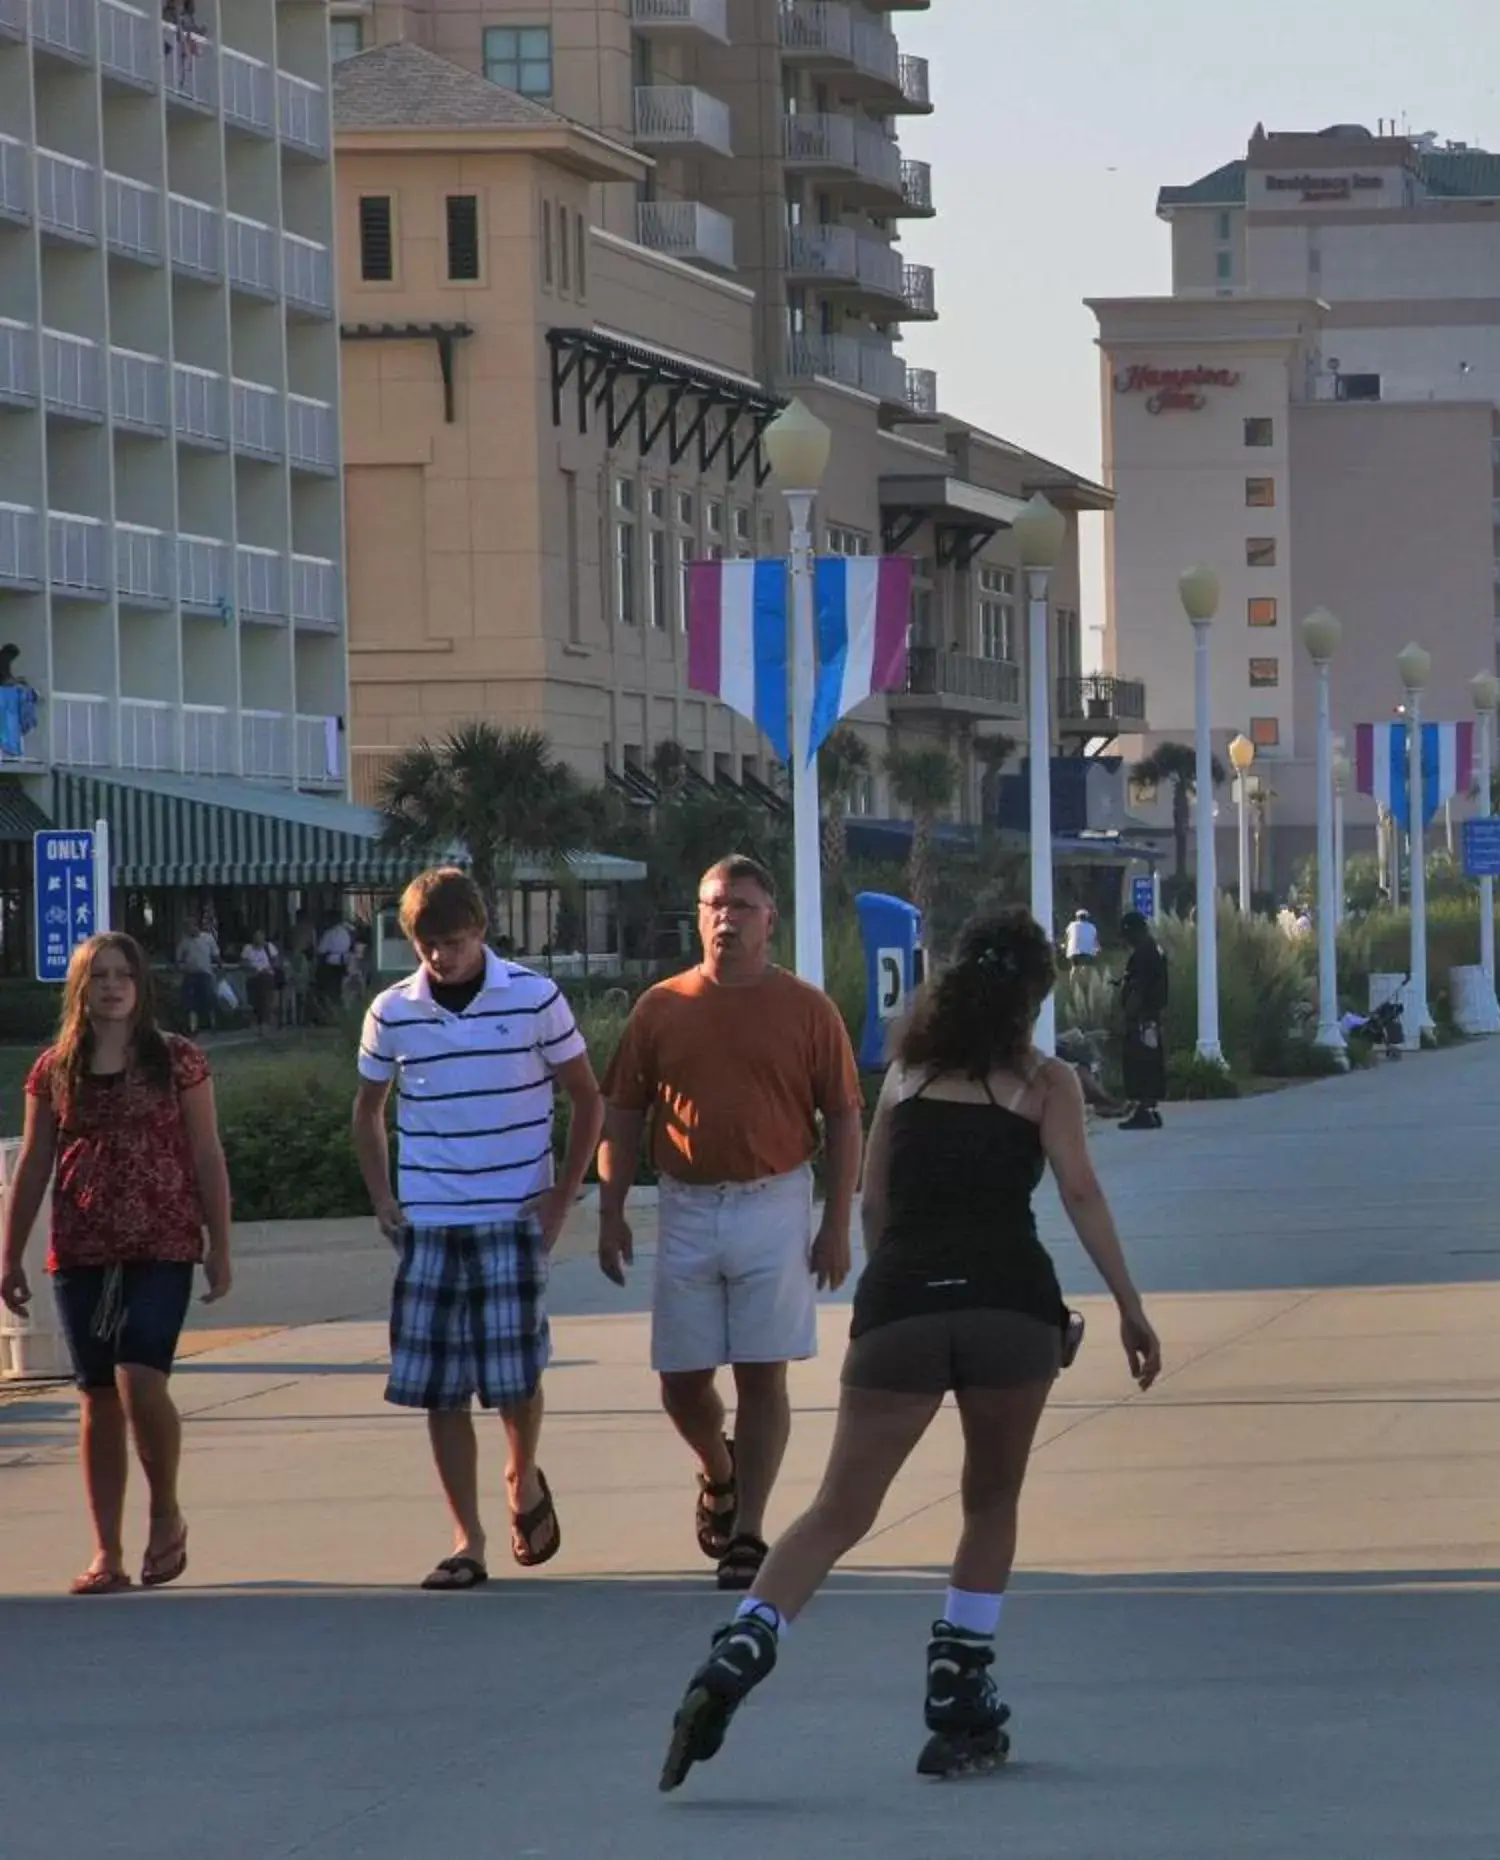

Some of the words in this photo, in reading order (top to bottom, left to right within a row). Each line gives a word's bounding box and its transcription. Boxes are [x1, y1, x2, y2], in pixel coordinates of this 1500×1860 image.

[1352, 173, 1384, 190] Inn
[1114, 364, 1241, 393] Hampton
[1145, 388, 1206, 415] Inn
[47, 838, 89, 860] ONLY
